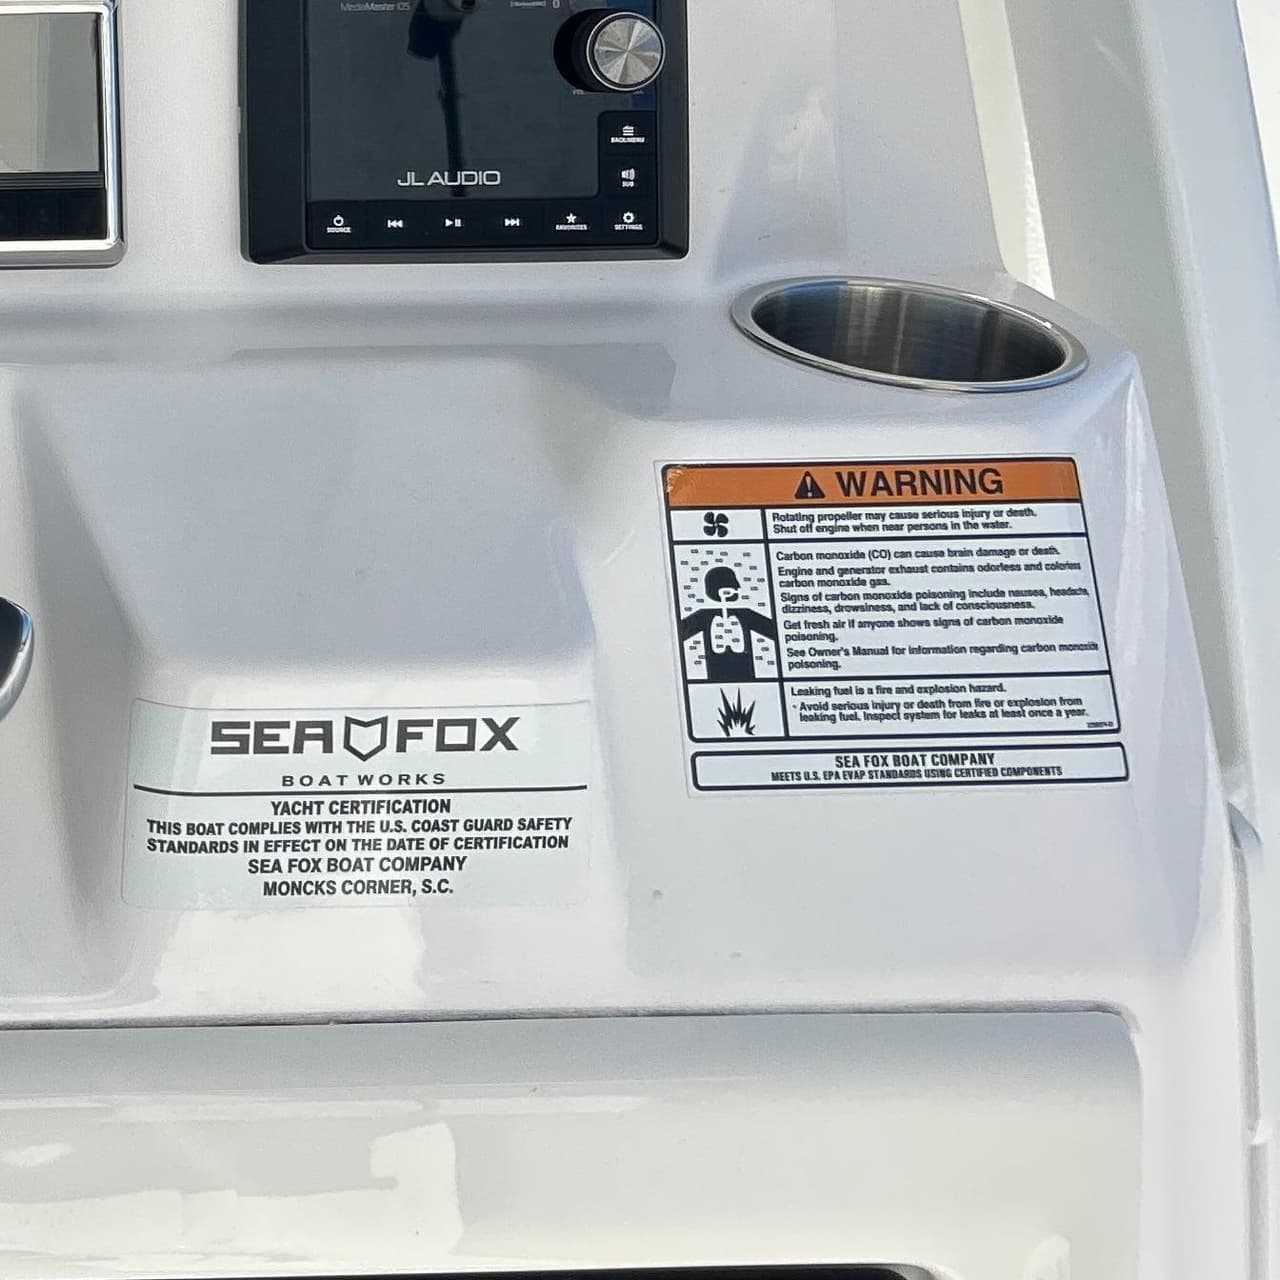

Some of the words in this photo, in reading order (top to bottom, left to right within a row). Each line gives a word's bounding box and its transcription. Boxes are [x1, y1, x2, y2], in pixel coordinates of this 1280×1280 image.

[397, 171, 425, 187] JL
[427, 170, 501, 186] AUDIO
[836, 468, 1004, 496] WARNING
[772, 512, 814, 524] Rotating
[817, 511, 863, 524] propeller
[865, 512, 886, 522] may
[889, 511, 919, 520] cause
[921, 509, 959, 519] serious
[962, 509, 990, 521] injury
[992, 510, 1003, 518] or
[1006, 508, 1037, 518] death.
[210, 720, 333, 755] SEA
[395, 717, 521, 752] FOX
[835, 754, 861, 769] SEA
[864, 754, 889, 768] FOX
[893, 753, 928, 768] BOAT
[931, 752, 995, 767] COMPANY
[281, 775, 348, 787] BOAT
[358, 773, 446, 786] WORKS
[771, 771, 802, 781] MEETS
[804, 770, 821, 781] U.S.
[823, 770, 841, 780] EPA
[842, 769, 866, 780] EVAP
[867, 768, 921, 780] STANDARDS
[924, 768, 952, 779] USING
[954, 767, 999, 778] CERTIFIED
[1000, 766, 1062, 777] COMPONENTS
[271, 801, 326, 816] YACHT
[328, 799, 451, 815] CERTIFICATION
[146, 819, 182, 835] THIS
[186, 821, 224, 836] BOAT
[227, 820, 301, 835] COMPLIES
[304, 819, 342, 834] WITH
[347, 819, 376, 834] THE
[379, 819, 407, 833] U.S.
[411, 819, 459, 833] COAST
[463, 818, 512, 832] GUARD
[517, 817, 572, 831] SAFETY
[146, 838, 239, 854] STANDARDS
[243, 840, 258, 853] IN
[263, 839, 321, 853] EFFECT
[324, 838, 347, 852] ON
[351, 838, 383, 851] THE
[386, 837, 425, 851] DATE
[428, 836, 450, 850] OF
[453, 835, 569, 850] CERTIFICATION
[248, 858, 283, 874] SEA
[287, 858, 323, 874] FOX
[327, 857, 374, 873] BOAT
[379, 856, 467, 872] COMPANY
[263, 880, 337, 896] MONCKS
[341, 879, 416, 897] CORNER,
[421, 878, 453, 894] S.C.
